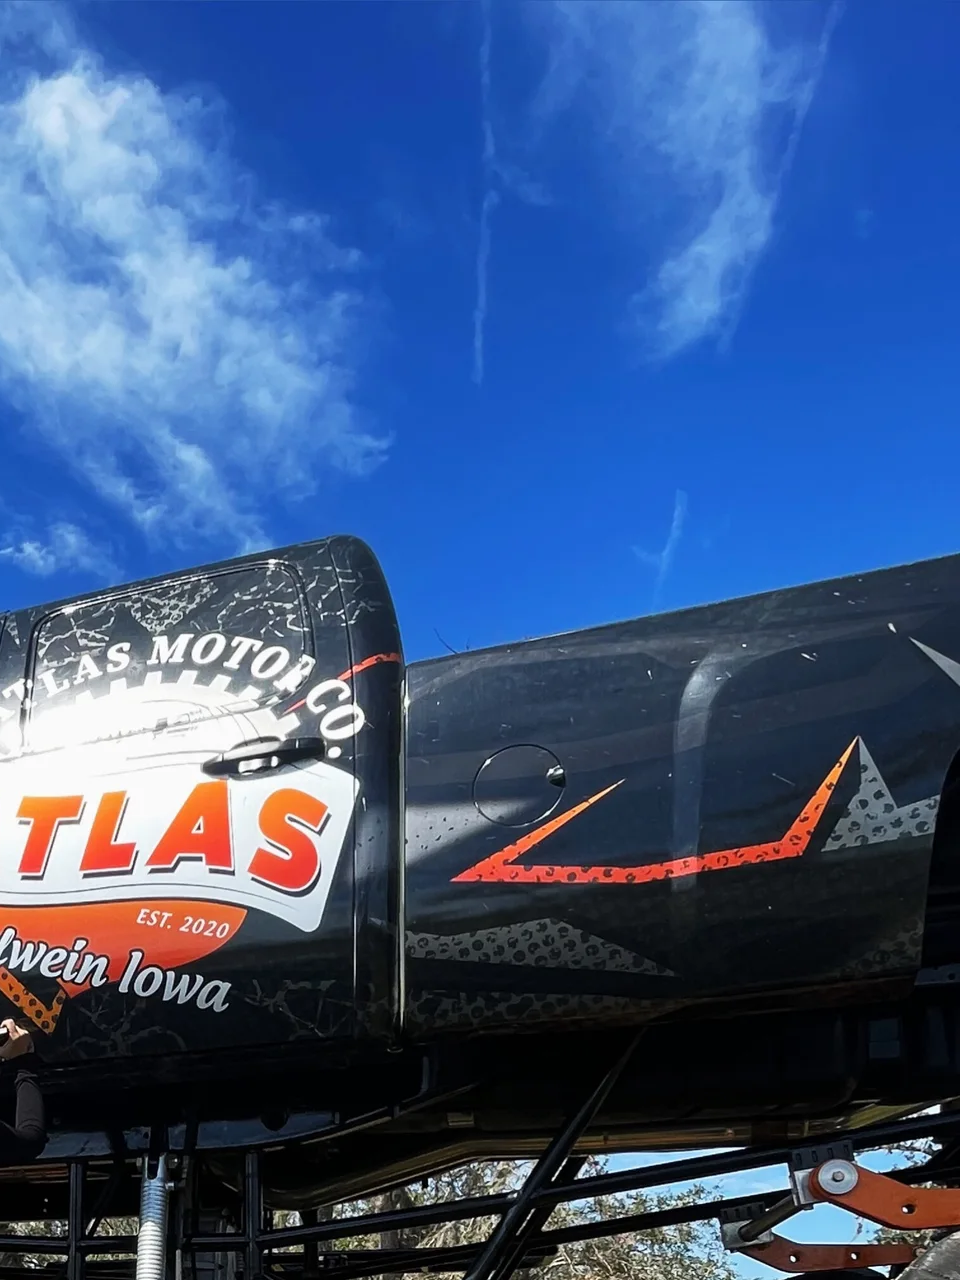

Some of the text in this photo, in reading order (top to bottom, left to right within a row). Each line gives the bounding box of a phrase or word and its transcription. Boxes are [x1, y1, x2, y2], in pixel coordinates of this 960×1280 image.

[147, 633, 316, 693] MOTOR
[306, 679, 365, 759] CO.
[136, 908, 230, 939] EST. 2020
[119, 951, 232, 1013] Iowa
